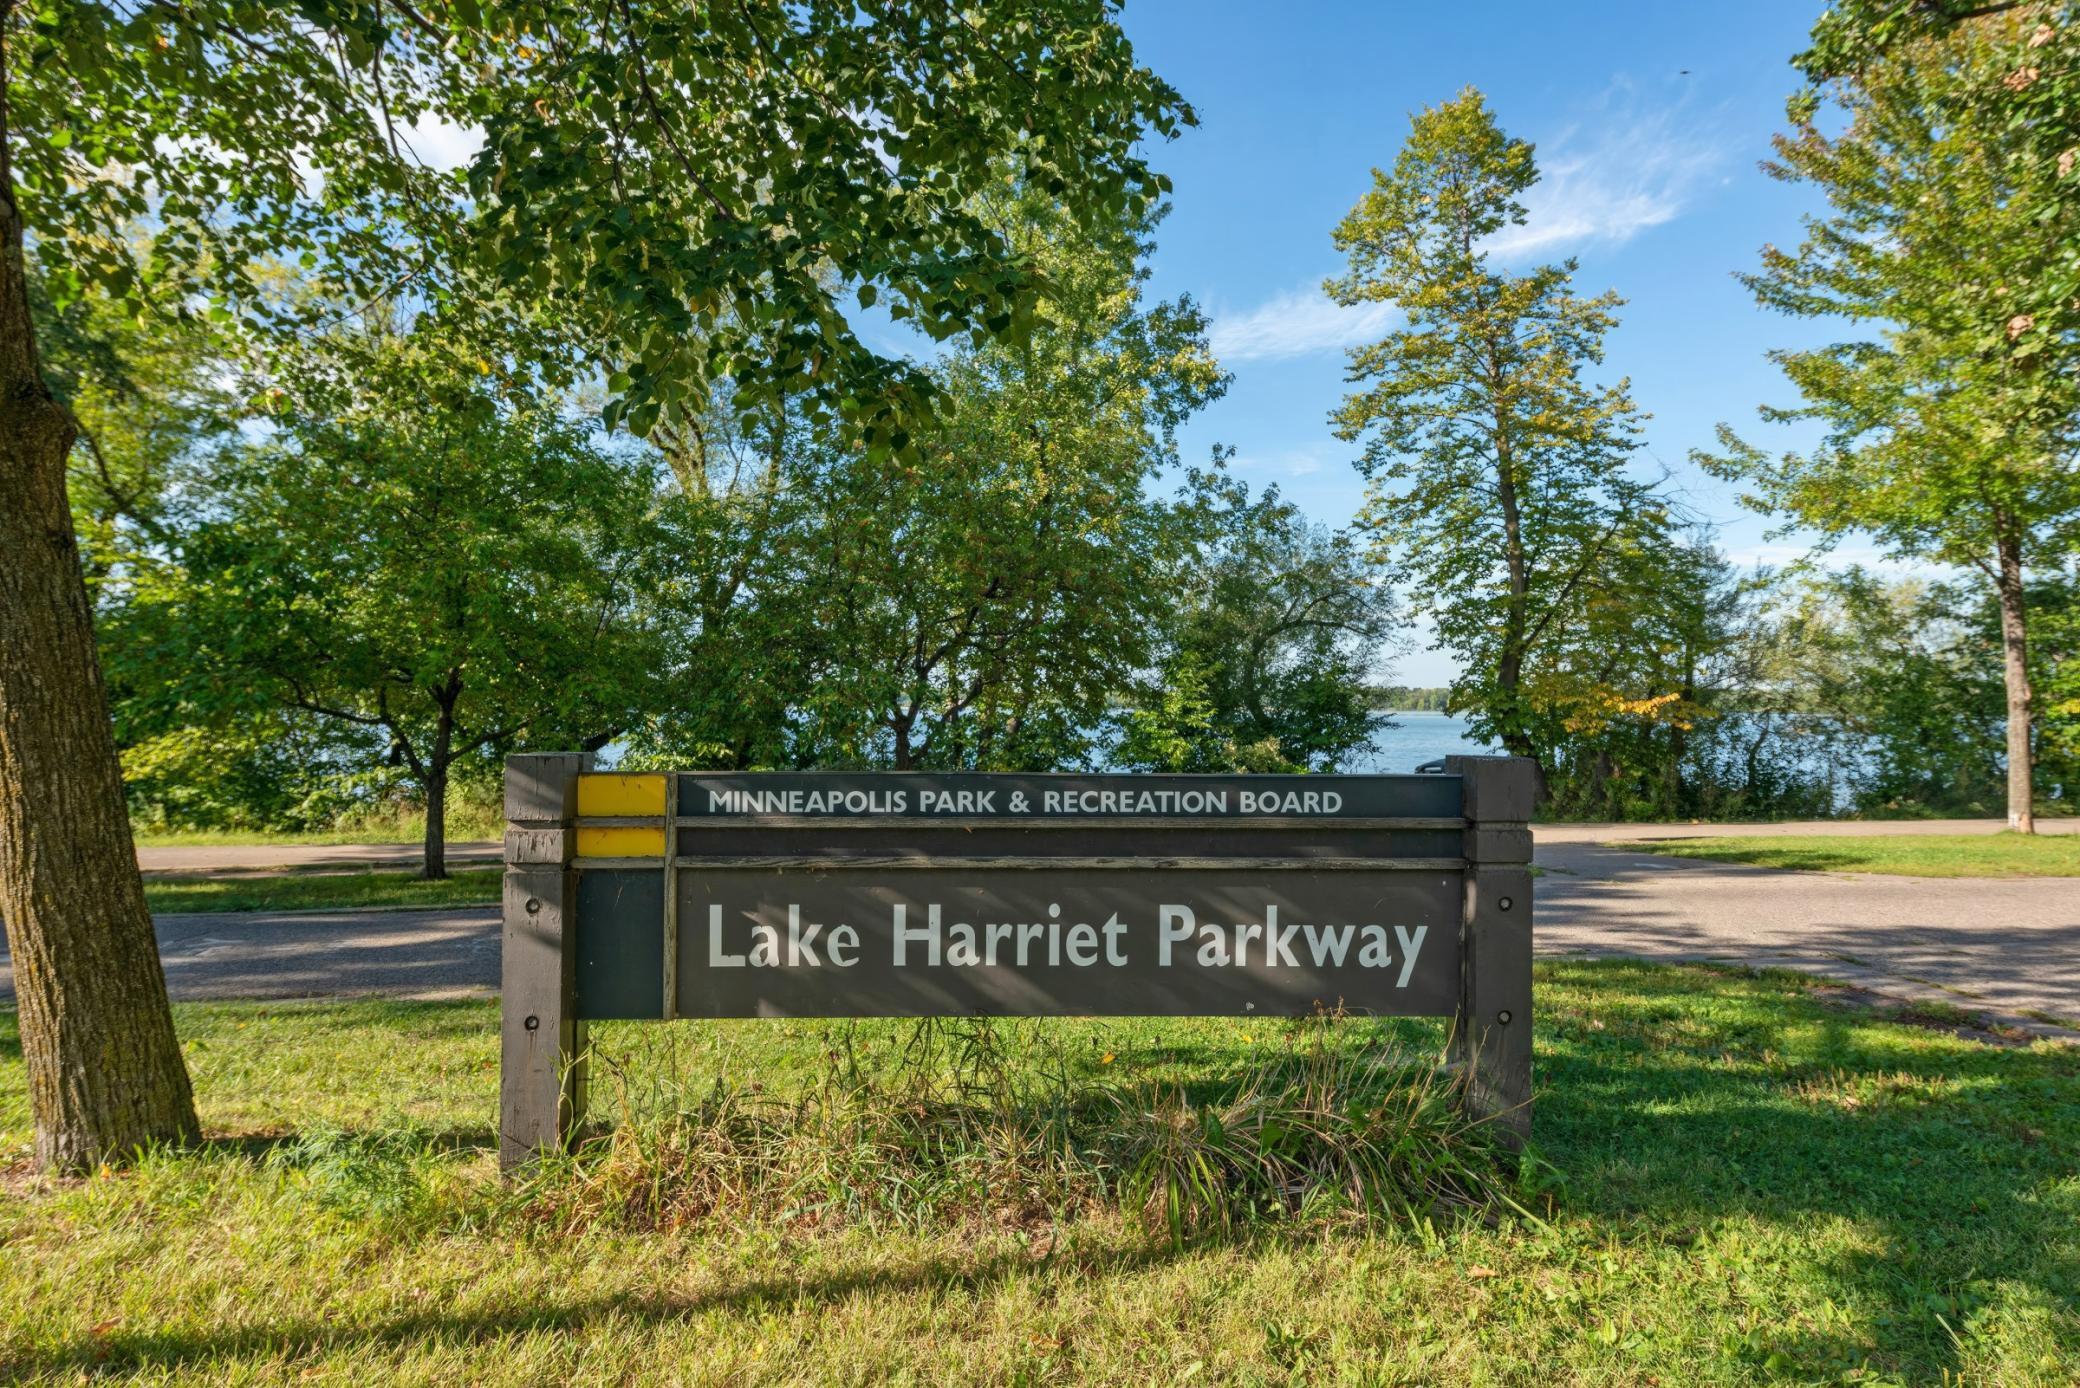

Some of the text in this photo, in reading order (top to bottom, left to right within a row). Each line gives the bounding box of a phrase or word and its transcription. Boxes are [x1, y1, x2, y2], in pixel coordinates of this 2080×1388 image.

[708, 790, 1343, 814] MINNEAPOLIS PARK & RECREATION BOARD
[708, 902, 1428, 989] Lake Harriet Parkway
